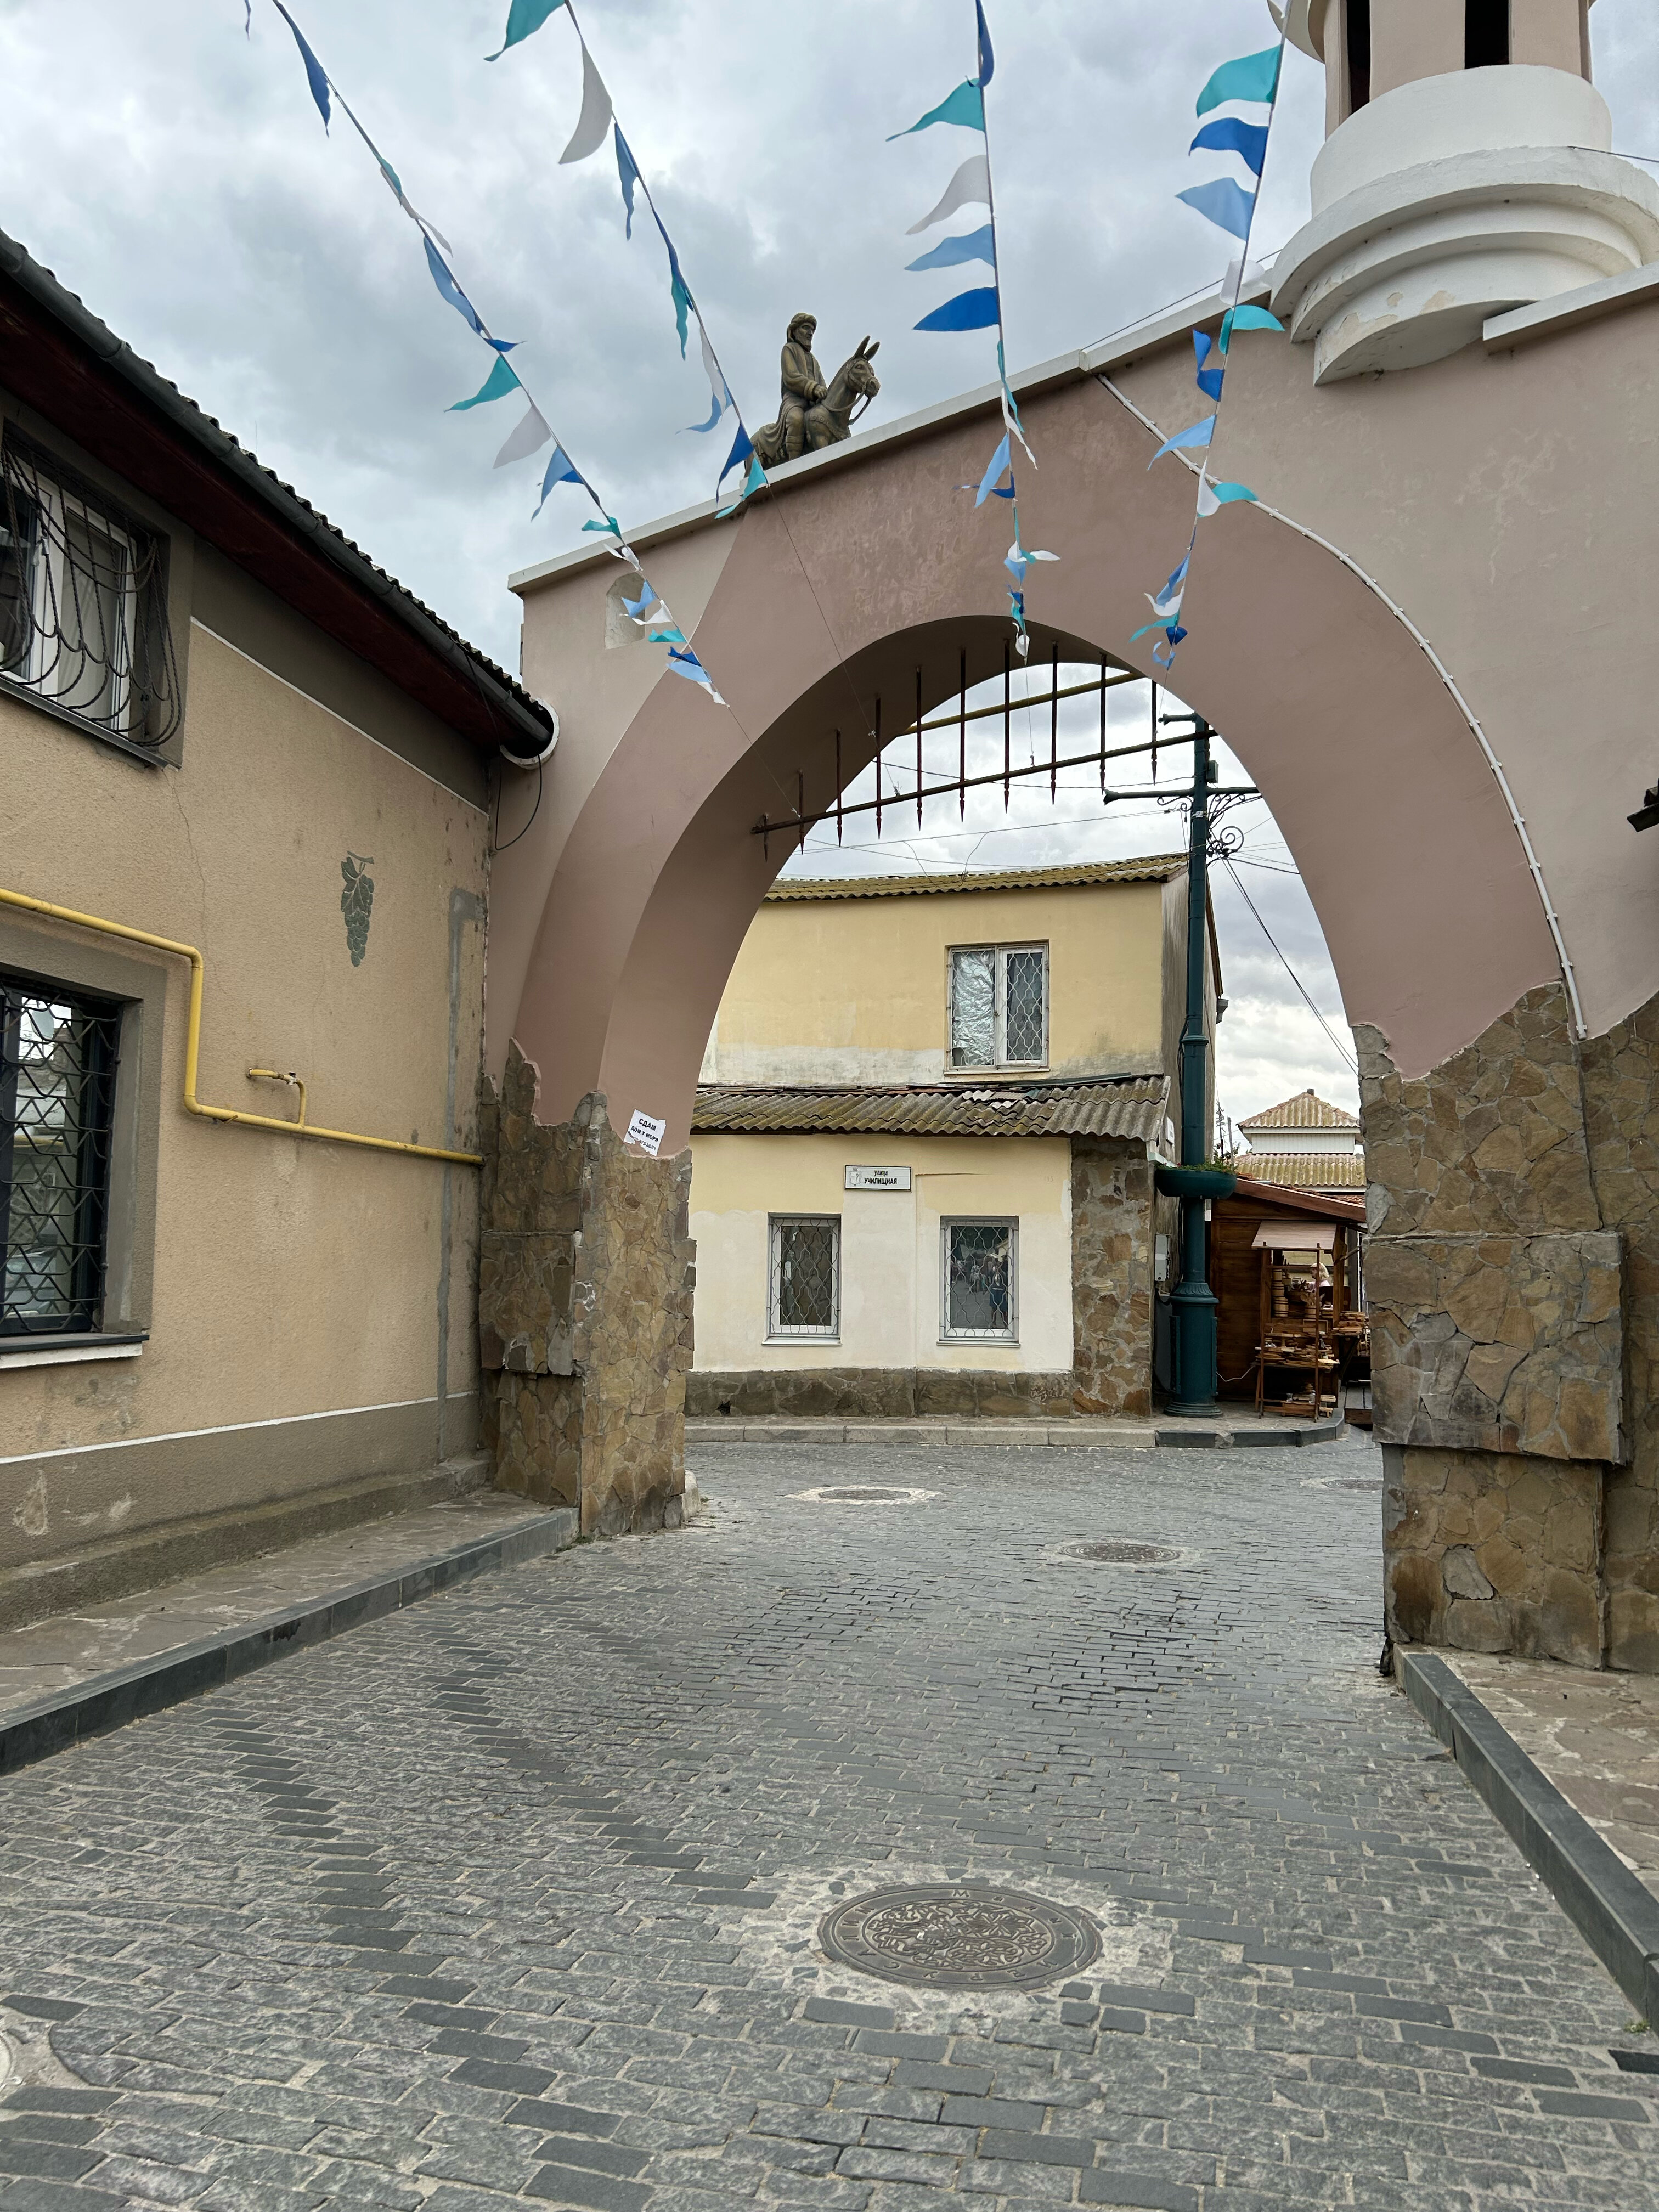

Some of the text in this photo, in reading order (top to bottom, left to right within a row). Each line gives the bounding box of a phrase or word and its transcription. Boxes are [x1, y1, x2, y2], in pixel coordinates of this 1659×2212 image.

[639, 1119, 656, 1131] СДАМ
[646, 1133, 658, 1142] МОРЯ
[865, 1177, 897, 1186] УЧИЛИЩНАЯ
